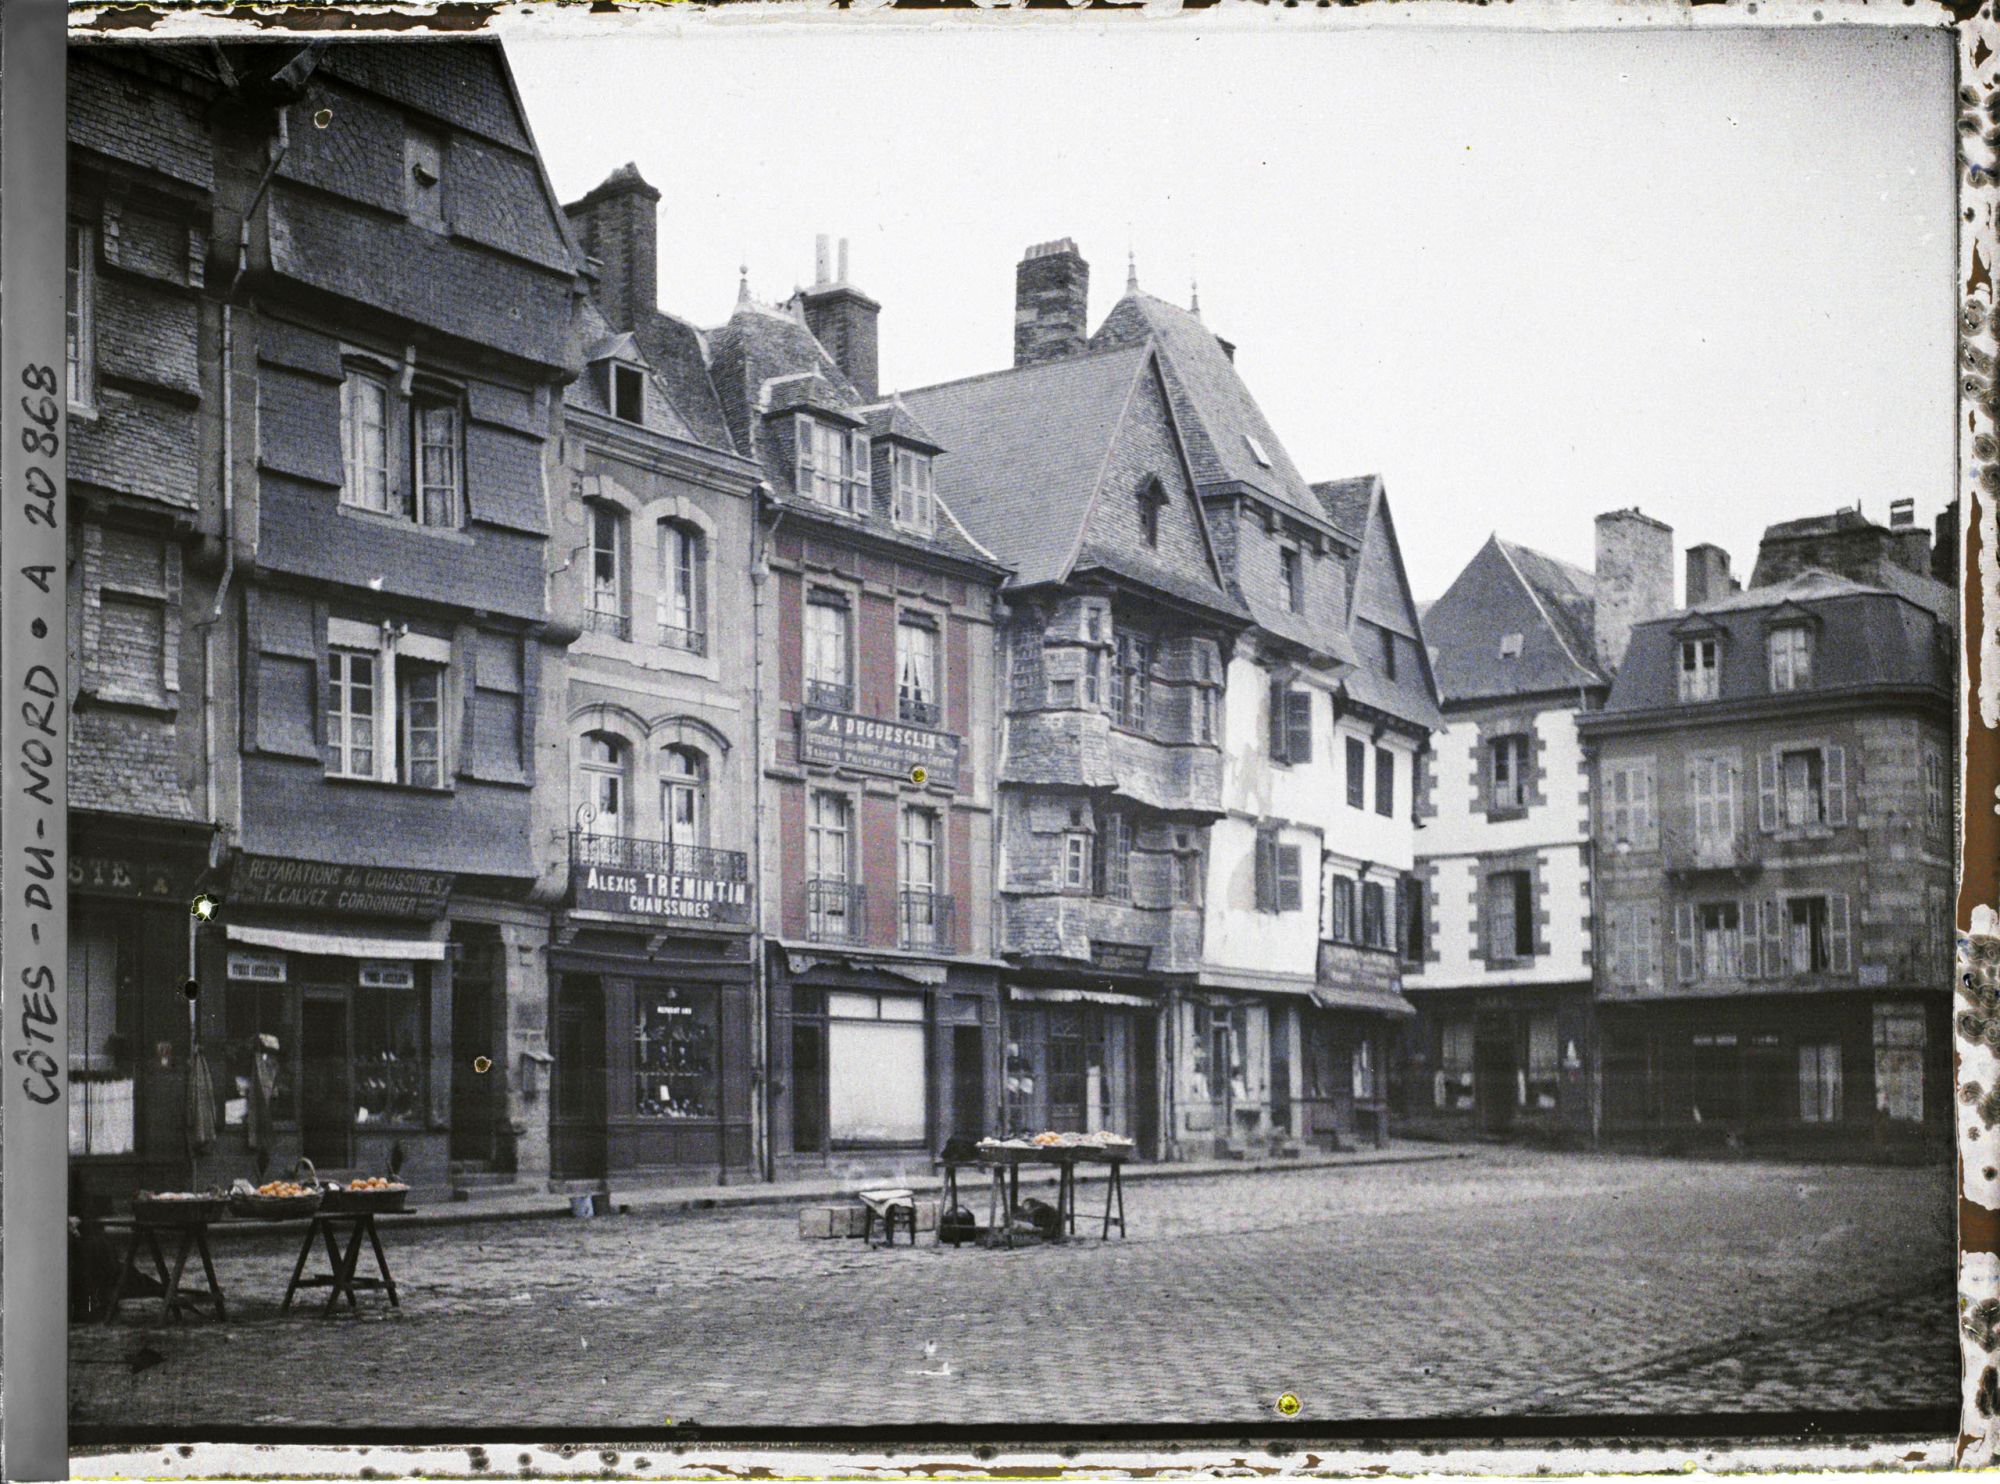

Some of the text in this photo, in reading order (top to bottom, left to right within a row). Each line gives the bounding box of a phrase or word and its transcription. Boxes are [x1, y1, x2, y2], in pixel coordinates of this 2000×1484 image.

[20, 363, 60, 529] 20868
[20, 565, 57, 594] A
[829, 715, 936, 749] A DUGUESCLIN
[338, 892, 417, 913] CORDONNIER
[645, 873, 746, 905] TREMINTIN
[629, 895, 710, 918] CHAUSSURES
